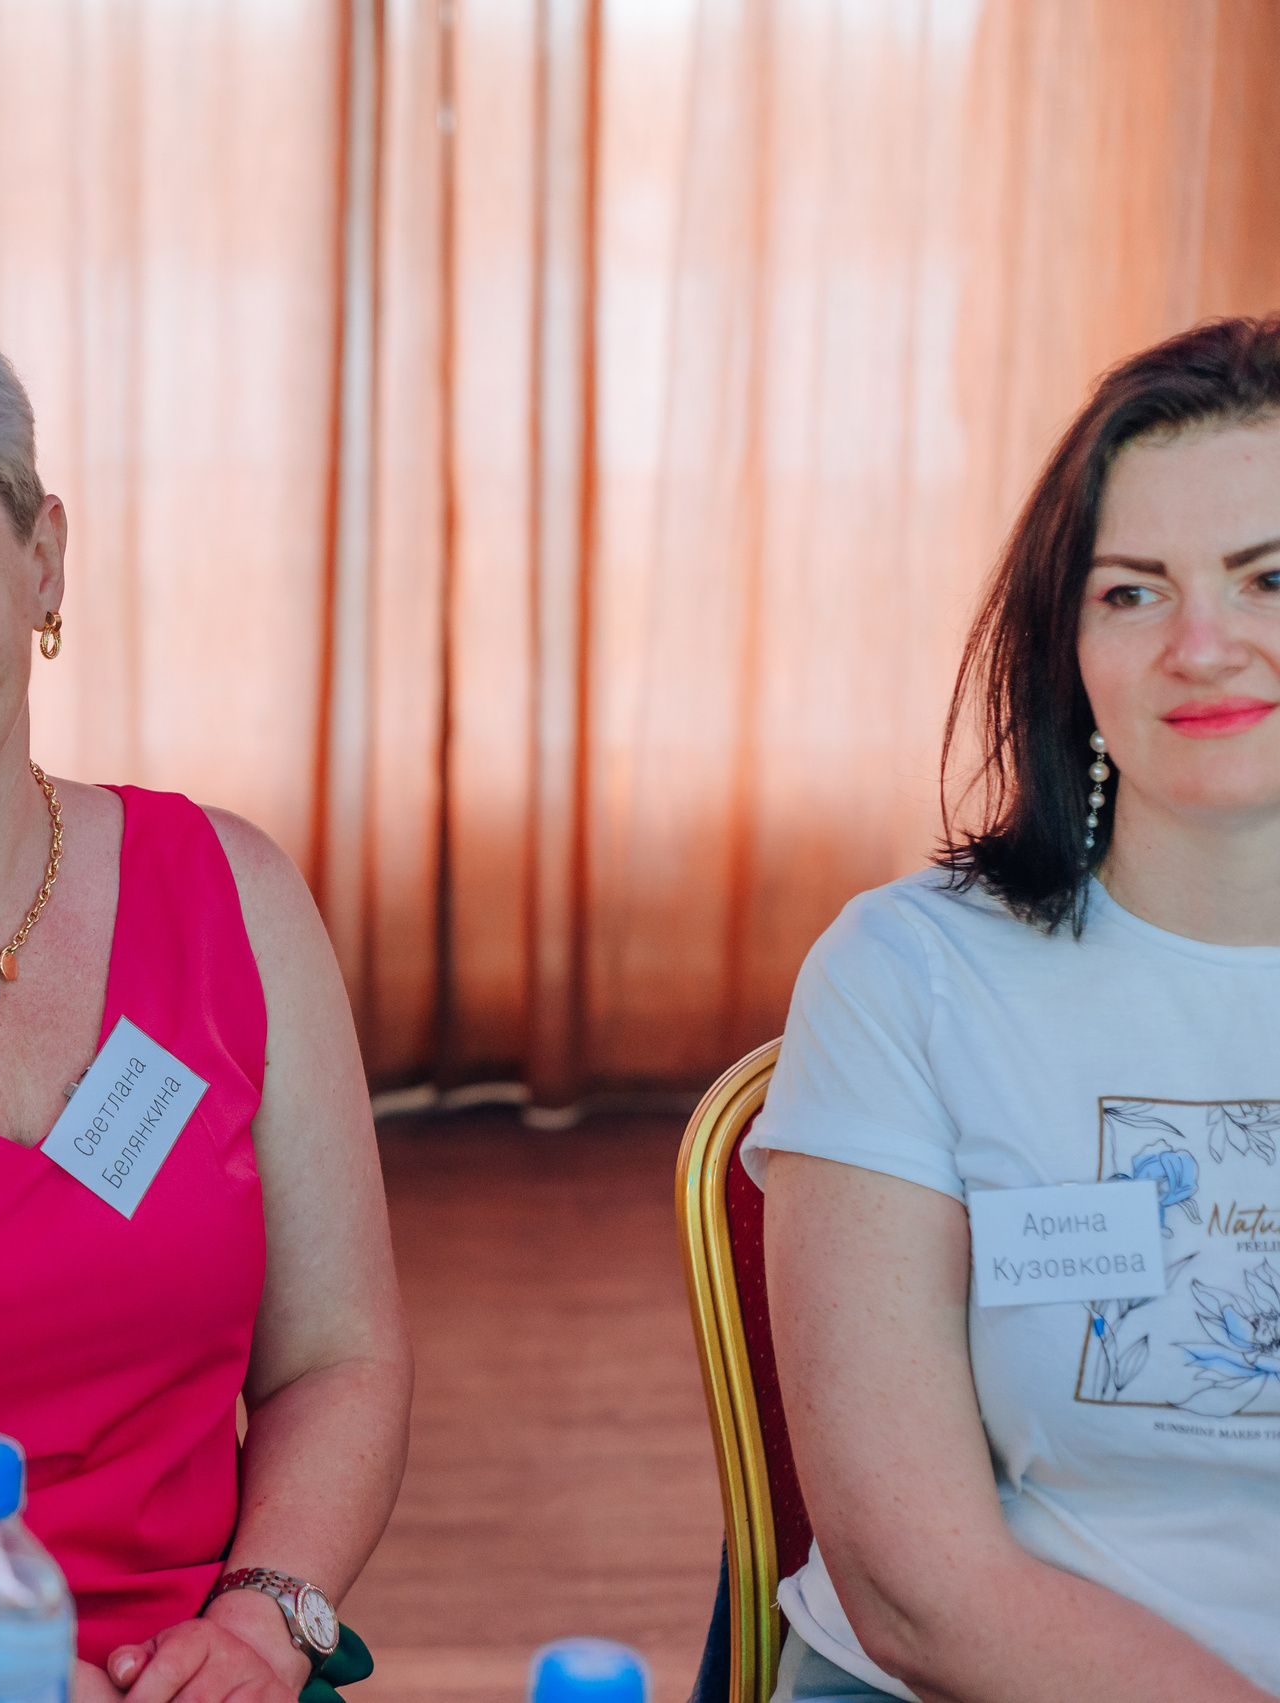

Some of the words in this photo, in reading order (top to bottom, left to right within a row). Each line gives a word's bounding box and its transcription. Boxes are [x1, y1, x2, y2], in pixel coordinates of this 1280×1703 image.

[73, 1057, 147, 1157] Светлана
[101, 1076, 182, 1189] Белянкина
[1022, 1212, 1108, 1240] Арина
[1208, 1199, 1280, 1240] Natu
[1237, 1241, 1280, 1252] FEELI
[992, 1252, 1147, 1286] Кузовкова
[1153, 1422, 1216, 1437] SUNSHINE
[1219, 1429, 1261, 1439] MAKES
